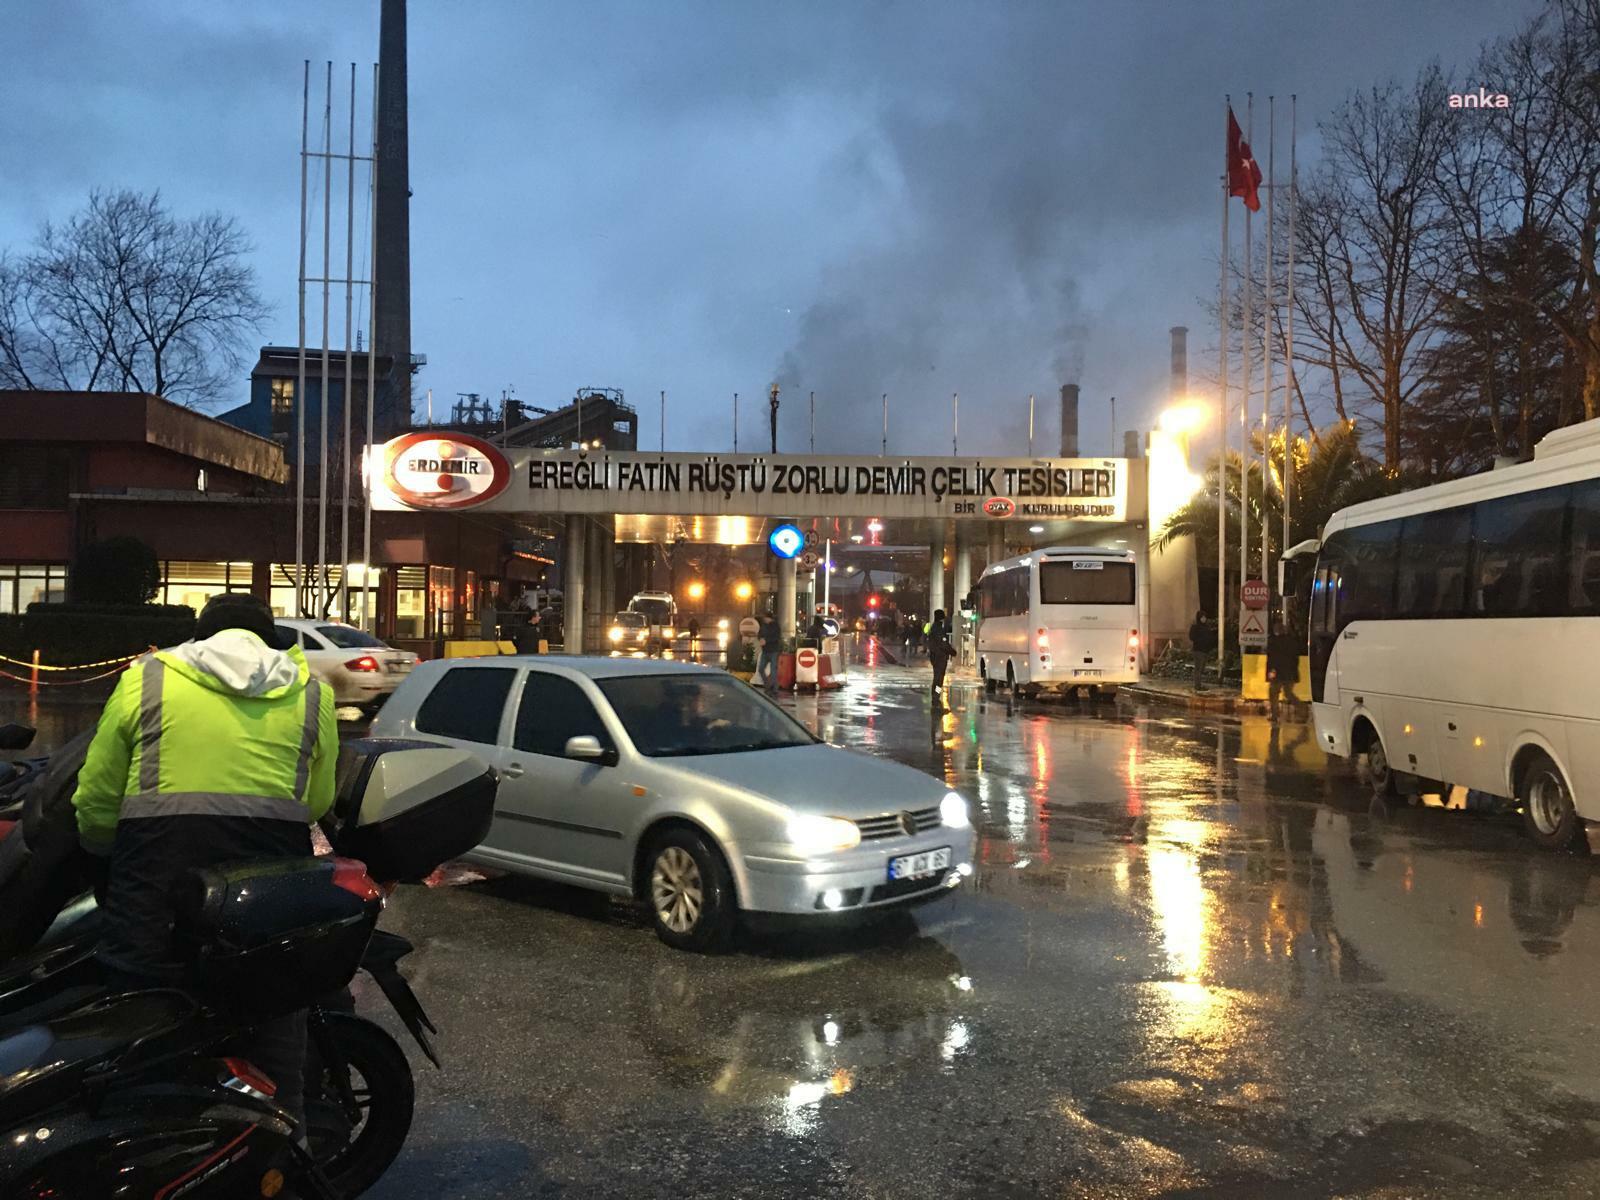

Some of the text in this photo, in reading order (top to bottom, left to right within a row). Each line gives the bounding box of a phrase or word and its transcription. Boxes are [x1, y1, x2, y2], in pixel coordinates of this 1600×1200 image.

[528, 453, 1116, 502] EREĞLİ FATİN RÜŞTÜ ZORLU DEMİR ÇELİK TESİSLERİ
[954, 498, 976, 514] BİR
[1244, 587, 1268, 595] DUR
